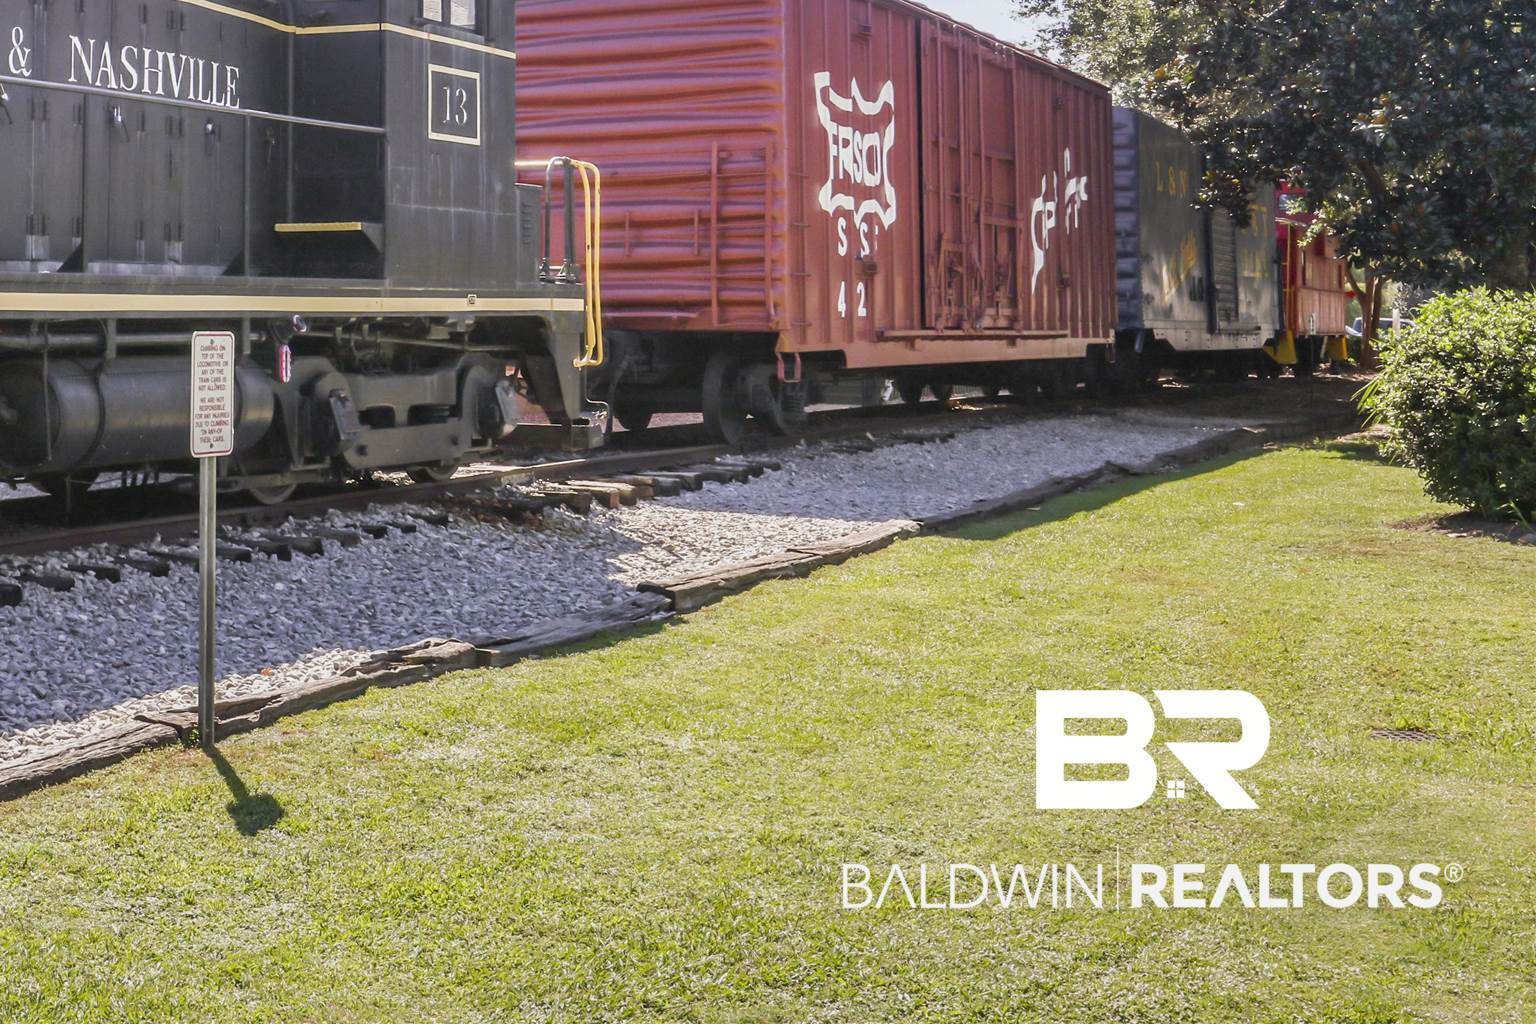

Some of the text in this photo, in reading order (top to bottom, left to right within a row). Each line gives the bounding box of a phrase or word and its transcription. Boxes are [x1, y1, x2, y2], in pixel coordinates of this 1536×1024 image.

[8, 26, 33, 77] &
[67, 34, 240, 109] NASHVILLE
[441, 86, 468, 127] 13
